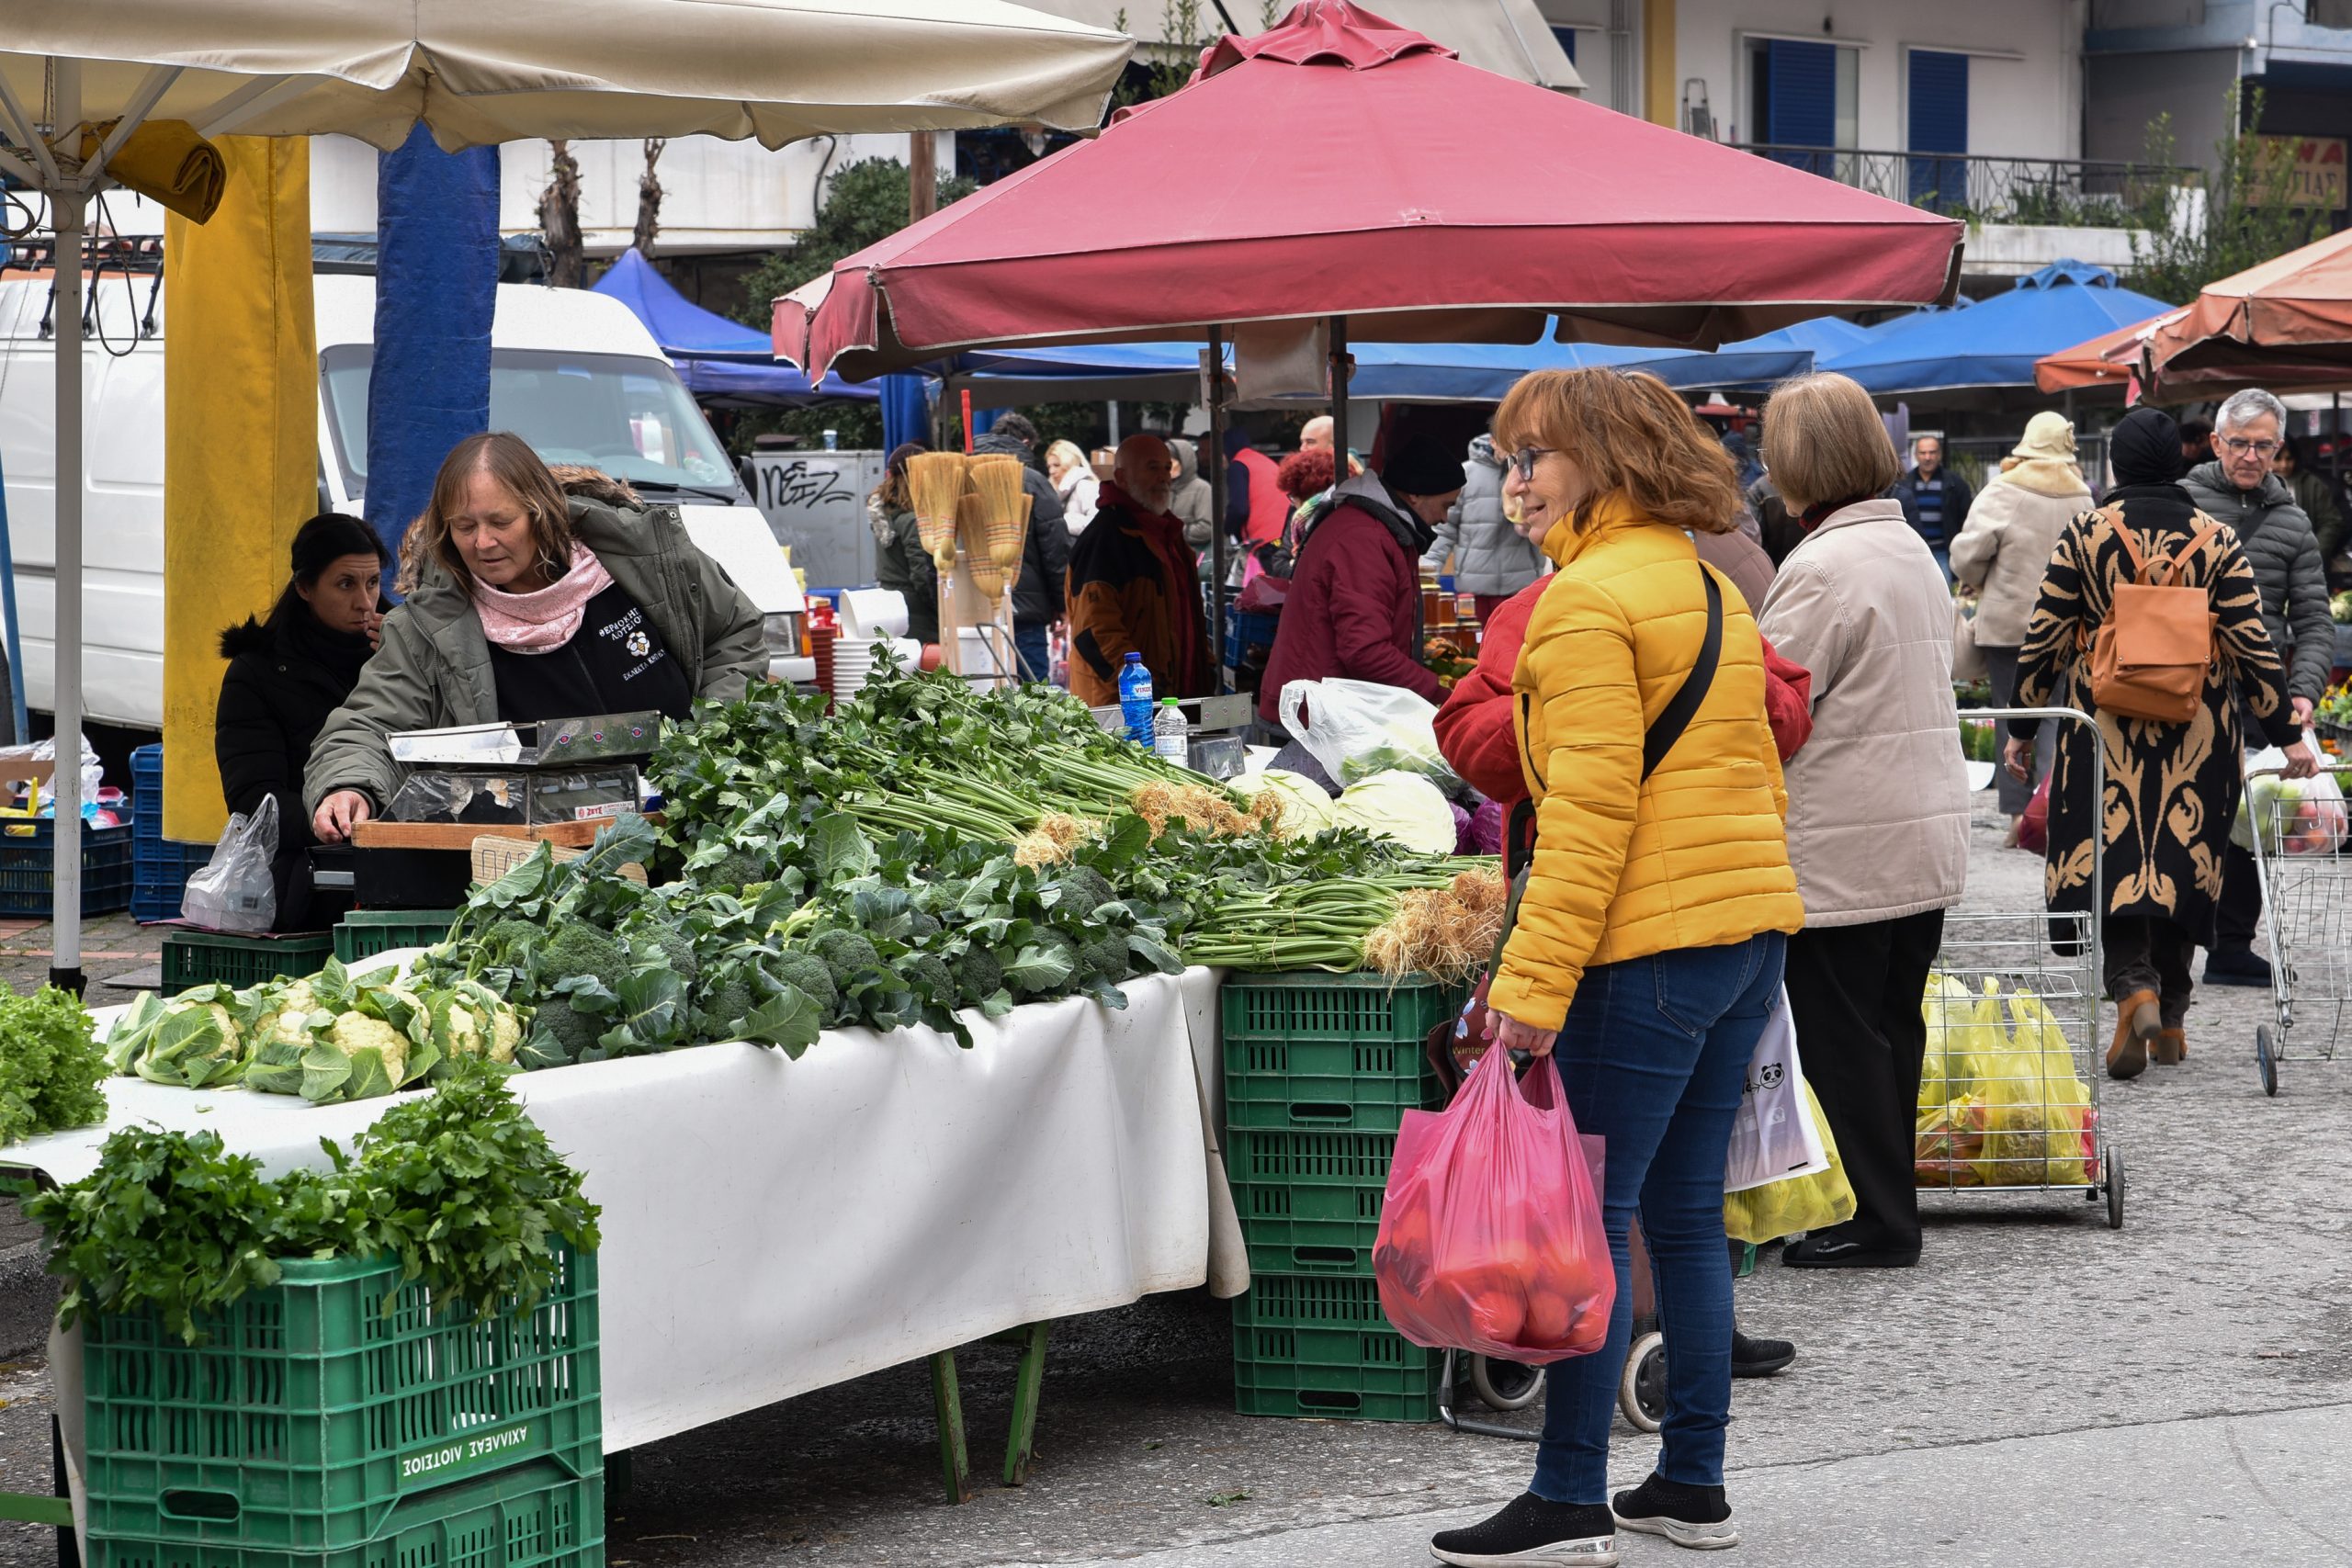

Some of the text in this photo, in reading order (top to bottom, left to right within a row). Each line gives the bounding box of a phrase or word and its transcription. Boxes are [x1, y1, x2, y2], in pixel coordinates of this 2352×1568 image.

[1453, 1046, 1485, 1055] Winter
[402, 1426, 527, 1477] ΑΧΙΛΛΕΑΣ ΛΙΟΤΣΙΟΣ
